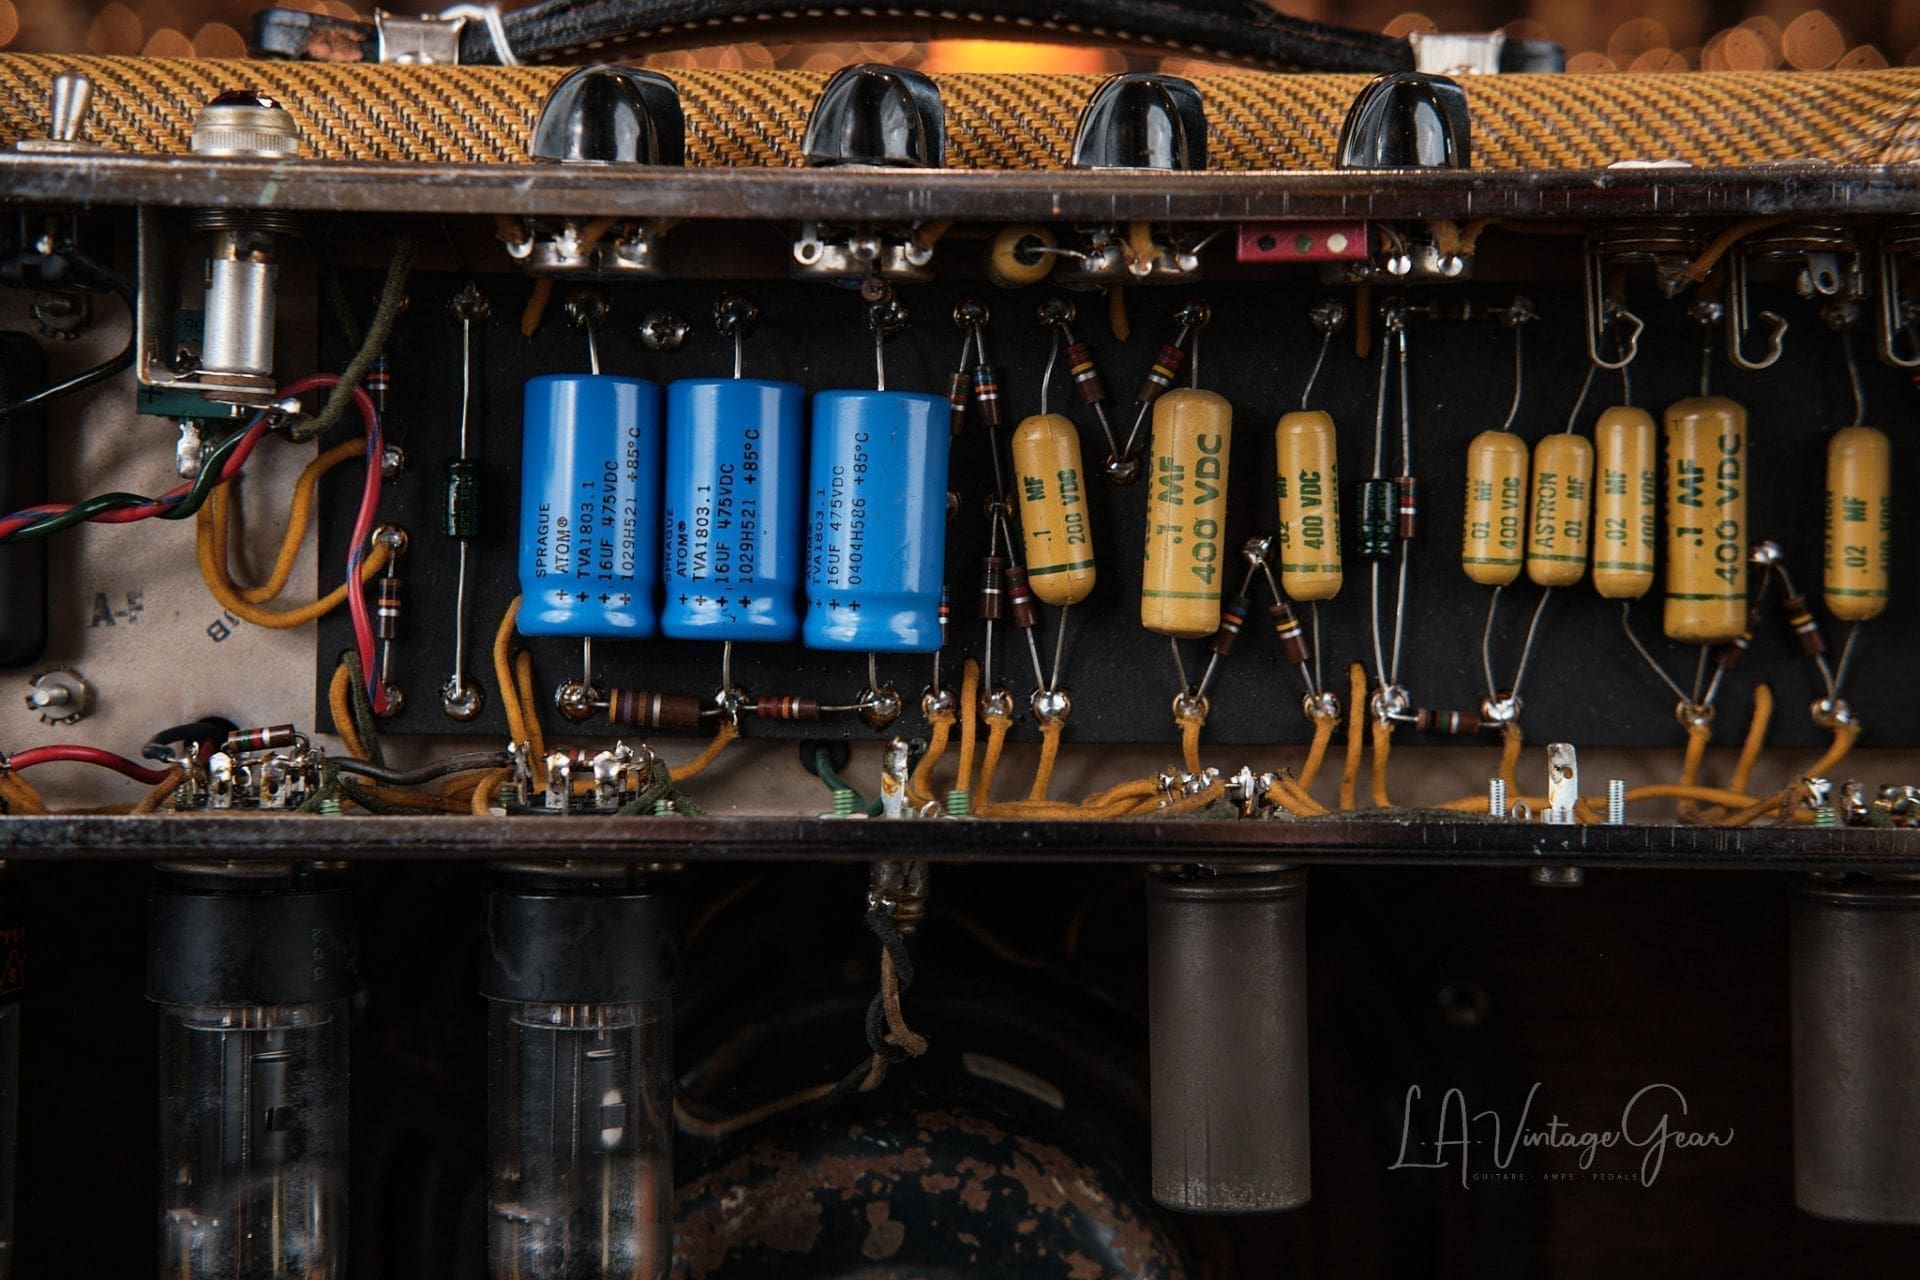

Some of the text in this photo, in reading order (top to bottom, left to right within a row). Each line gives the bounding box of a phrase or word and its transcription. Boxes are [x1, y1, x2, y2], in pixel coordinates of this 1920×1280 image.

[853, 432, 869, 485] +85°C
[1023, 476, 1045, 502] MF
[1157, 456, 1184, 506] MF
[1474, 478, 1492, 501] MF
[536, 502, 550, 578] SPRAGUE
[577, 481, 595, 579] TVA1803.1
[598, 460, 618, 581] 16UF 475VDC
[621, 497, 637, 581] 1029H521
[692, 485, 710, 583] TVA1803.1
[715, 463, 734, 584] 16UF 475VDC
[739, 428, 760, 584] 1029H521 +85°C
[813, 488, 825, 586] TVA1803.1
[828, 465, 844, 586] 16UF 475VDC
[1057, 469, 1085, 544] 200 VDC
[1191, 434, 1221, 585] 400 VDC
[1299, 469, 1324, 550] 400 VDC
[1499, 477, 1519, 549] 400 VDC
[1535, 472, 1557, 549] ASTRON
[1564, 475, 1584, 544] .01 MF
[1604, 469, 1627, 547] .02 MF
[1676, 459, 1704, 547] .1 MF
[1715, 434, 1741, 584] 400 VDC
[1843, 495, 1867, 574] .02 MF
